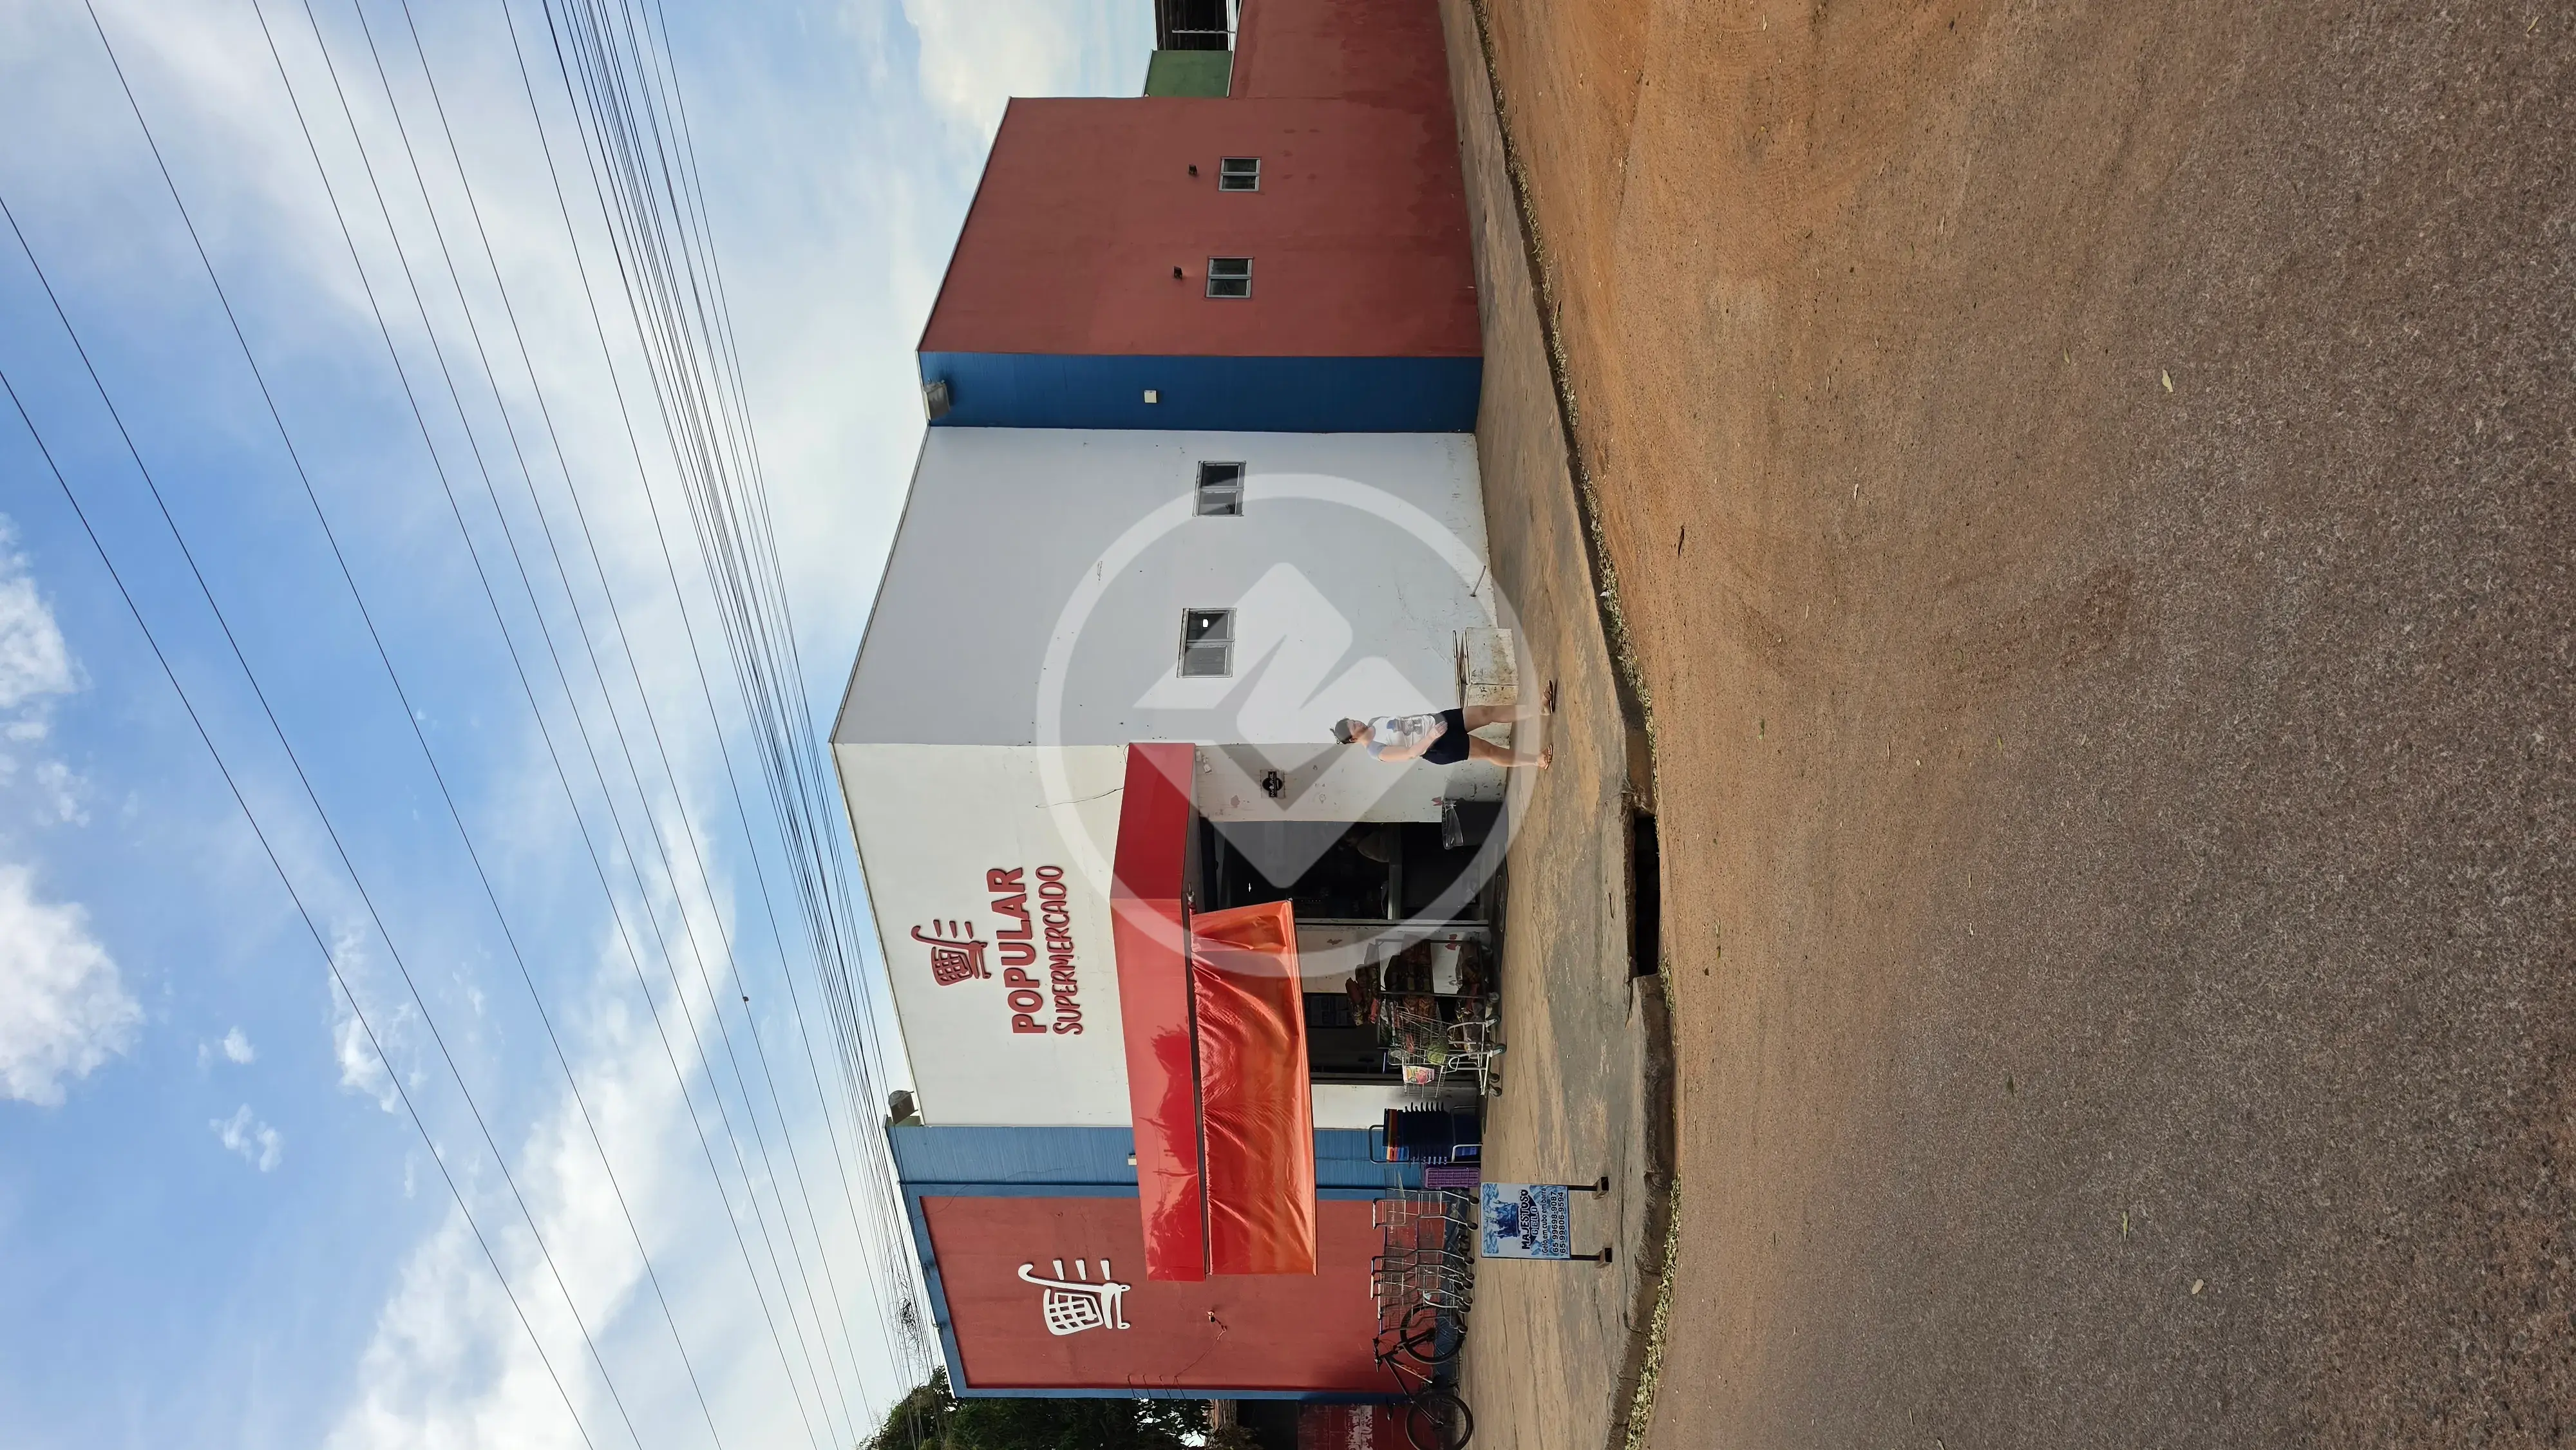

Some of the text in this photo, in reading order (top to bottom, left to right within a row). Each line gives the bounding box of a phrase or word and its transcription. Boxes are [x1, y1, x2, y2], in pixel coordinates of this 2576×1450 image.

[987, 867, 1046, 1033] POPULAR
[1036, 866, 1083, 1035] SUPERMERCADO
[1520, 1189, 1530, 1249] MAJESTOSO
[1530, 1207, 1539, 1236] GELO
[1542, 1204, 1547, 1213] em
[1542, 1230, 1548, 1239] em
[1553, 1243, 1558, 1252] 65
